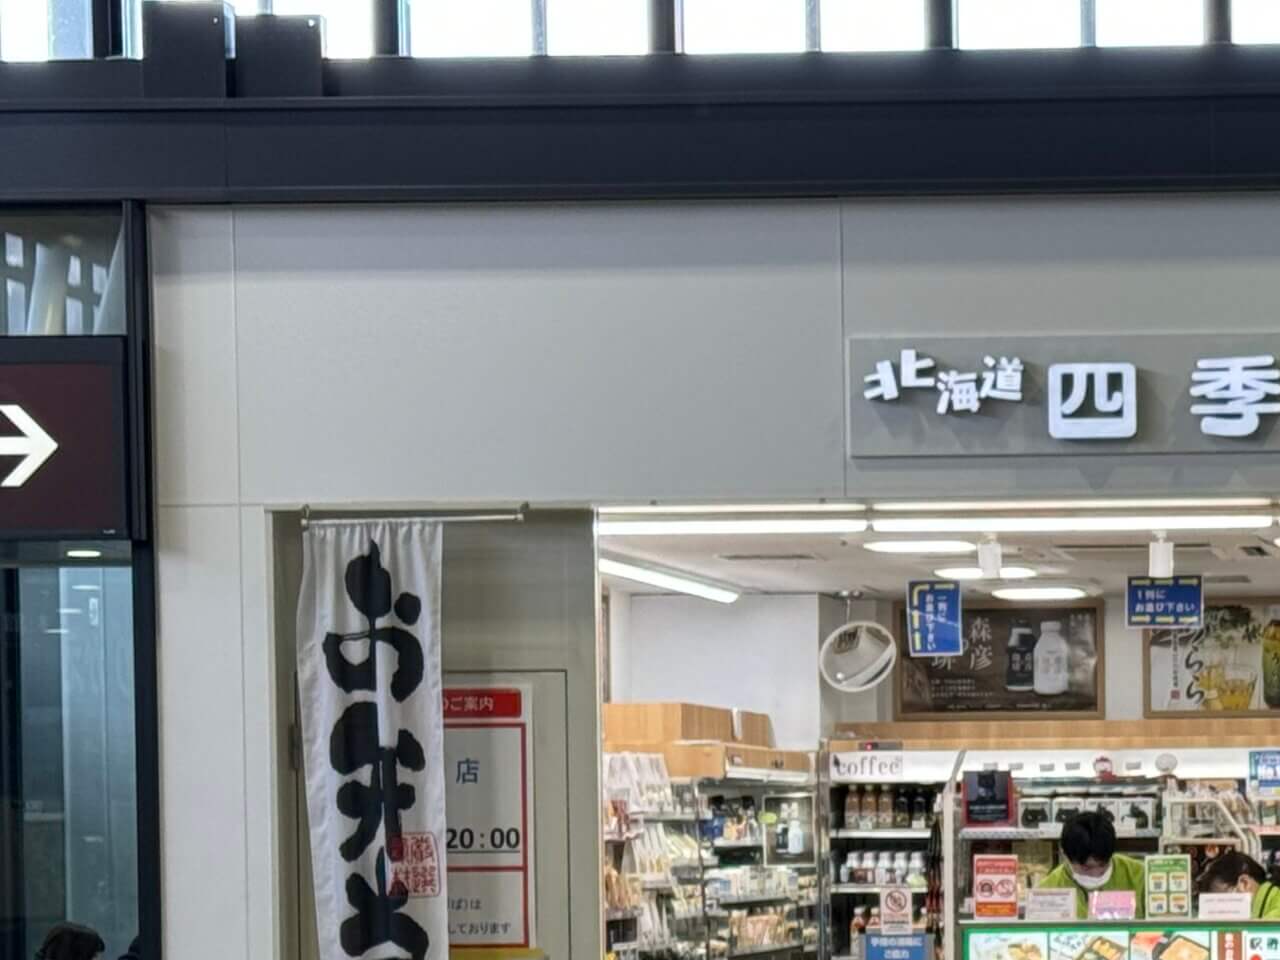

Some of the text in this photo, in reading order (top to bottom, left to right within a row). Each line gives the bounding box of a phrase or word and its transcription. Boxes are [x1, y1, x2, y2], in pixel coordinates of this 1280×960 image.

[863, 349, 1025, 415] 北海道
[456, 758, 480, 784] 店
[446, 827, 520, 849] 20:00
